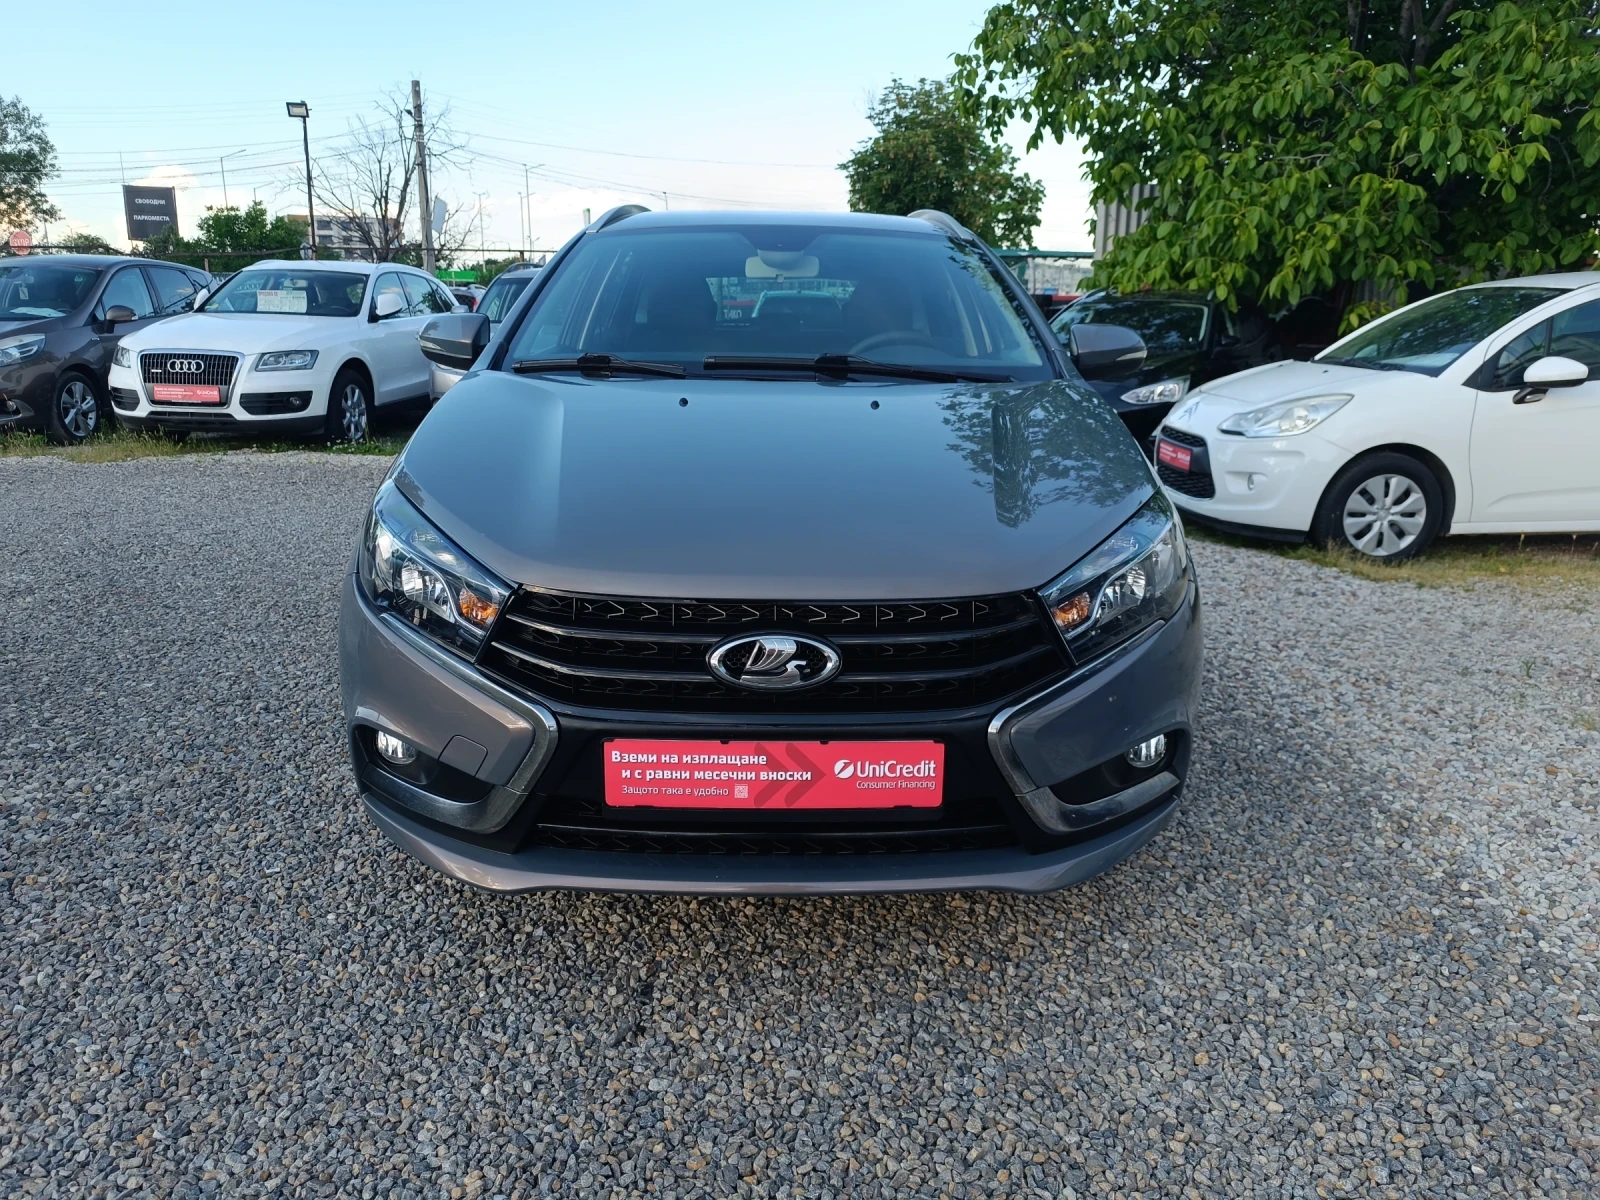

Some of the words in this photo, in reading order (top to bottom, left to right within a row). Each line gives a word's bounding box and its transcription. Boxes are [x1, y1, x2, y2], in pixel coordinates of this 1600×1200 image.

[133, 214, 170, 222] ПАРКОМЕСТА
[12, 238, 30, 247] STOP
[611, 750, 657, 763] Вземи
[661, 754, 679, 764] на
[682, 754, 767, 766] изплащане
[856, 760, 936, 778] UniCredit
[621, 769, 631, 779] и
[634, 770, 642, 779] с
[645, 770, 690, 782] равни
[694, 770, 756, 780] месечни
[759, 771, 812, 780] вноски
[621, 785, 659, 795] Защото
[661, 787, 683, 795] така
[694, 786, 729, 796] удобно
[856, 780, 896, 789] Consumer
[898, 780, 936, 790] Financing
